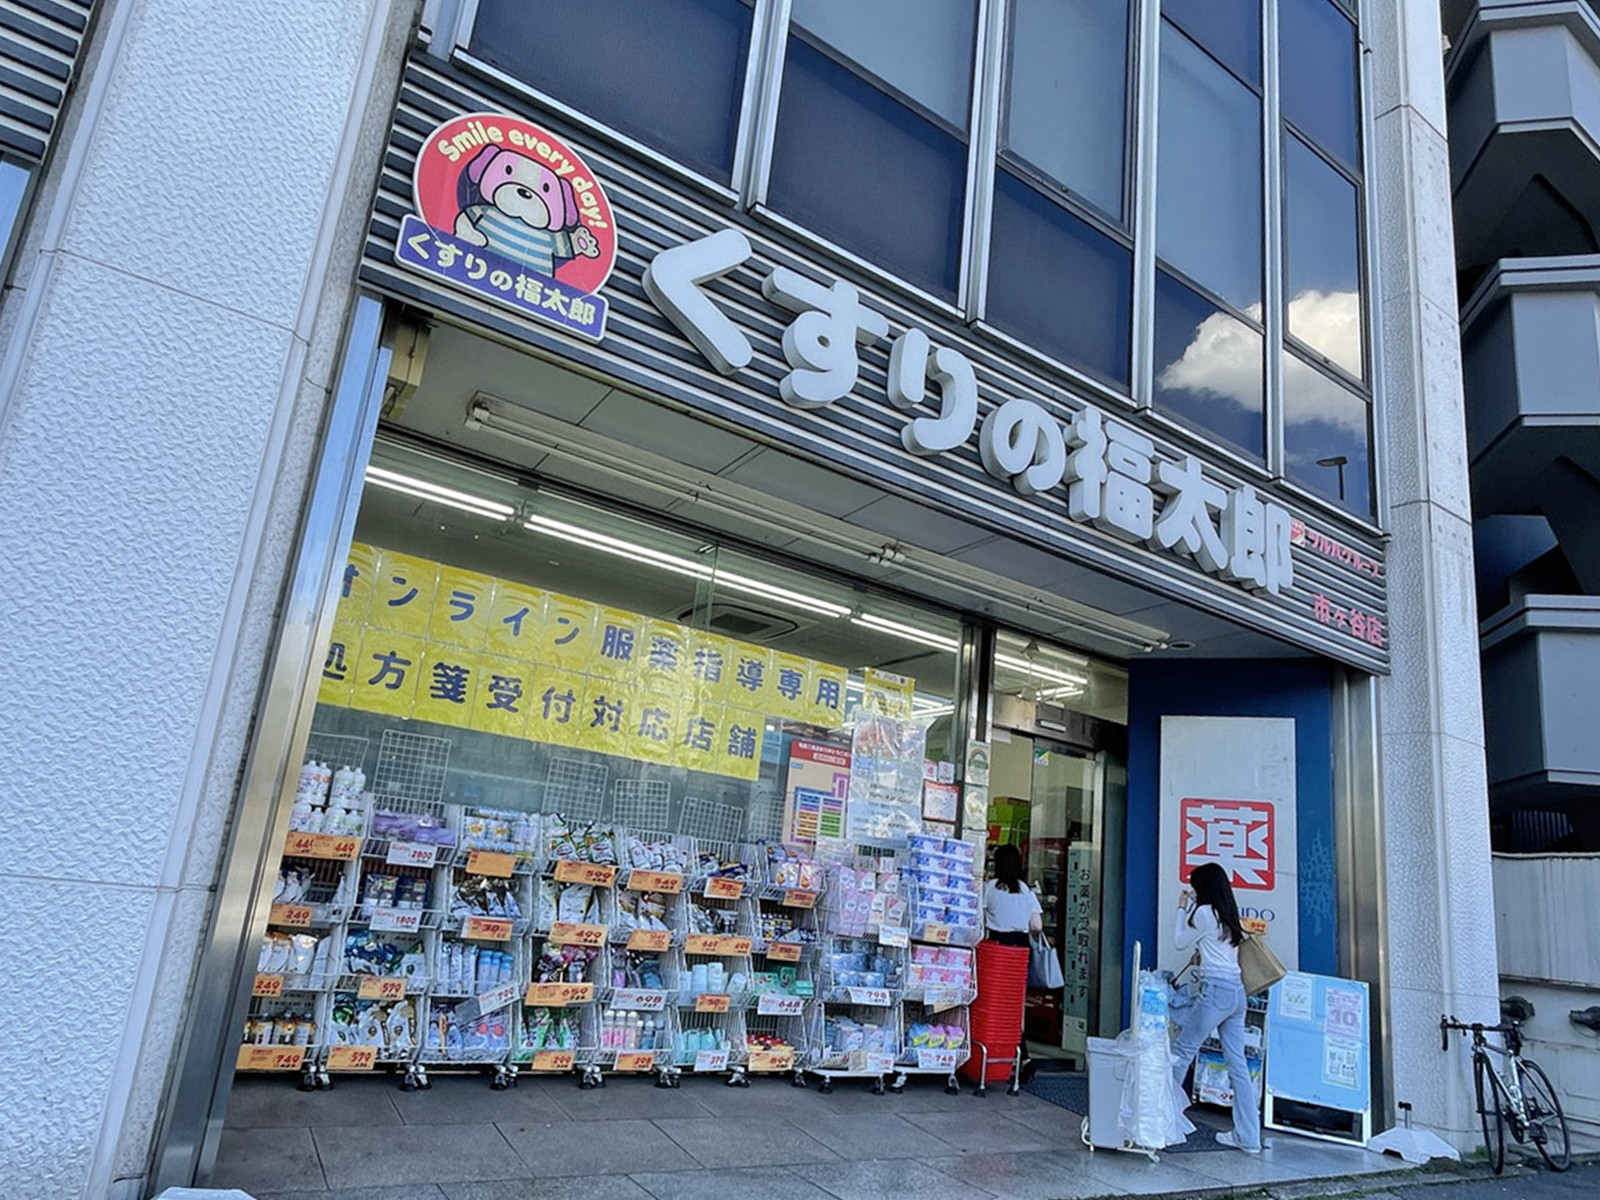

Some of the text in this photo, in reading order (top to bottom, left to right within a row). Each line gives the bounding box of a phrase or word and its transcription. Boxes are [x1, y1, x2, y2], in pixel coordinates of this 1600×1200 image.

[437, 120, 609, 229] Smile every day!
[406, 231, 597, 327] くすりの福太郎
[643, 227, 1294, 597] くすりの福太郎
[1308, 530, 1379, 578] ツルハグループ
[1185, 804, 1269, 886] 薬
[585, 869, 612, 879] 599
[653, 877, 678, 887] 549
[575, 929, 602, 939] 499
[1077, 868, 1091, 998] お薬が受取れます
[561, 986, 589, 996] 659
[635, 995, 662, 1004] 698
[778, 1000, 801, 1009] 648
